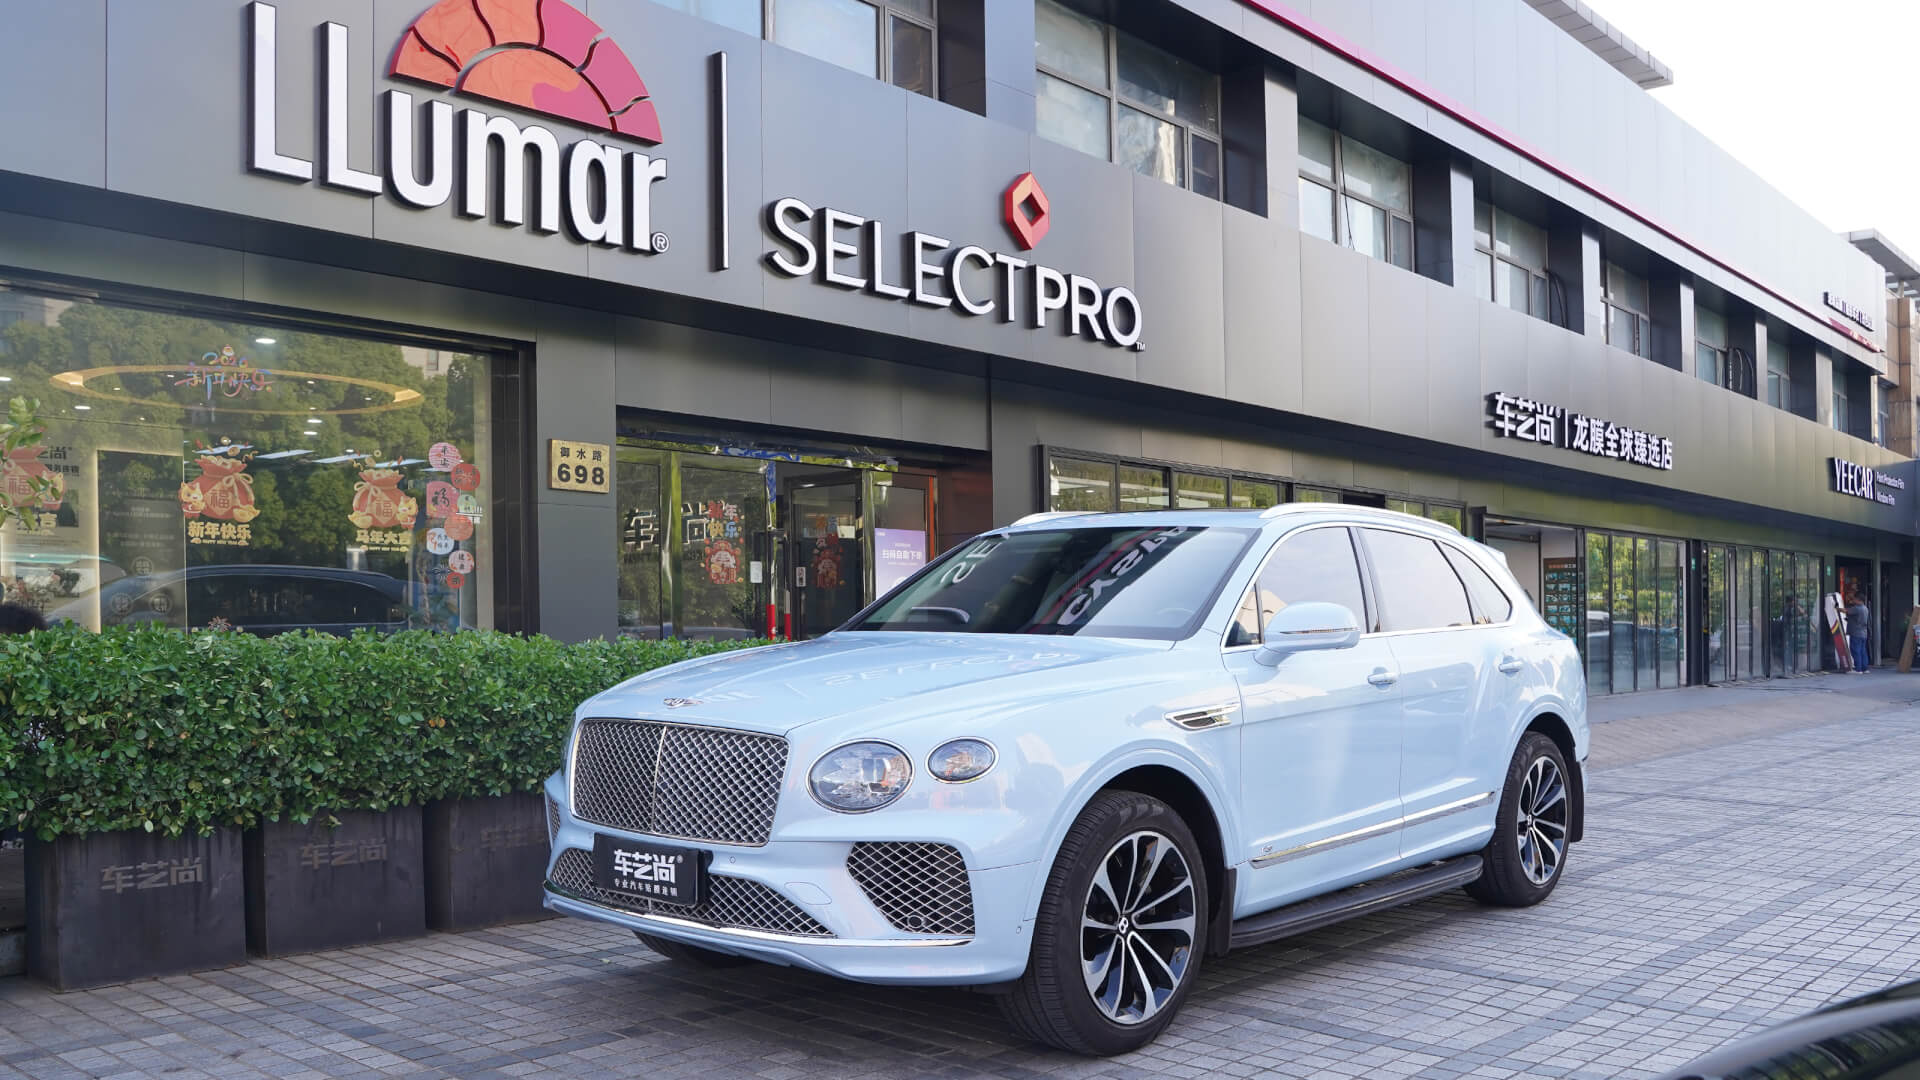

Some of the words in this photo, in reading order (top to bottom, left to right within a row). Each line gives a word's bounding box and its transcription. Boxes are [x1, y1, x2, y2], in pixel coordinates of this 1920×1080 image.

[247, 1, 667, 253] LLumar
[557, 463, 605, 486] 698
[1834, 457, 1874, 500] YEECAR
[188, 521, 252, 540] 新年快乐
[356, 529, 412, 545] 马年大吉
[101, 856, 203, 894] 车艺尚
[614, 849, 676, 883] 车艺尚
